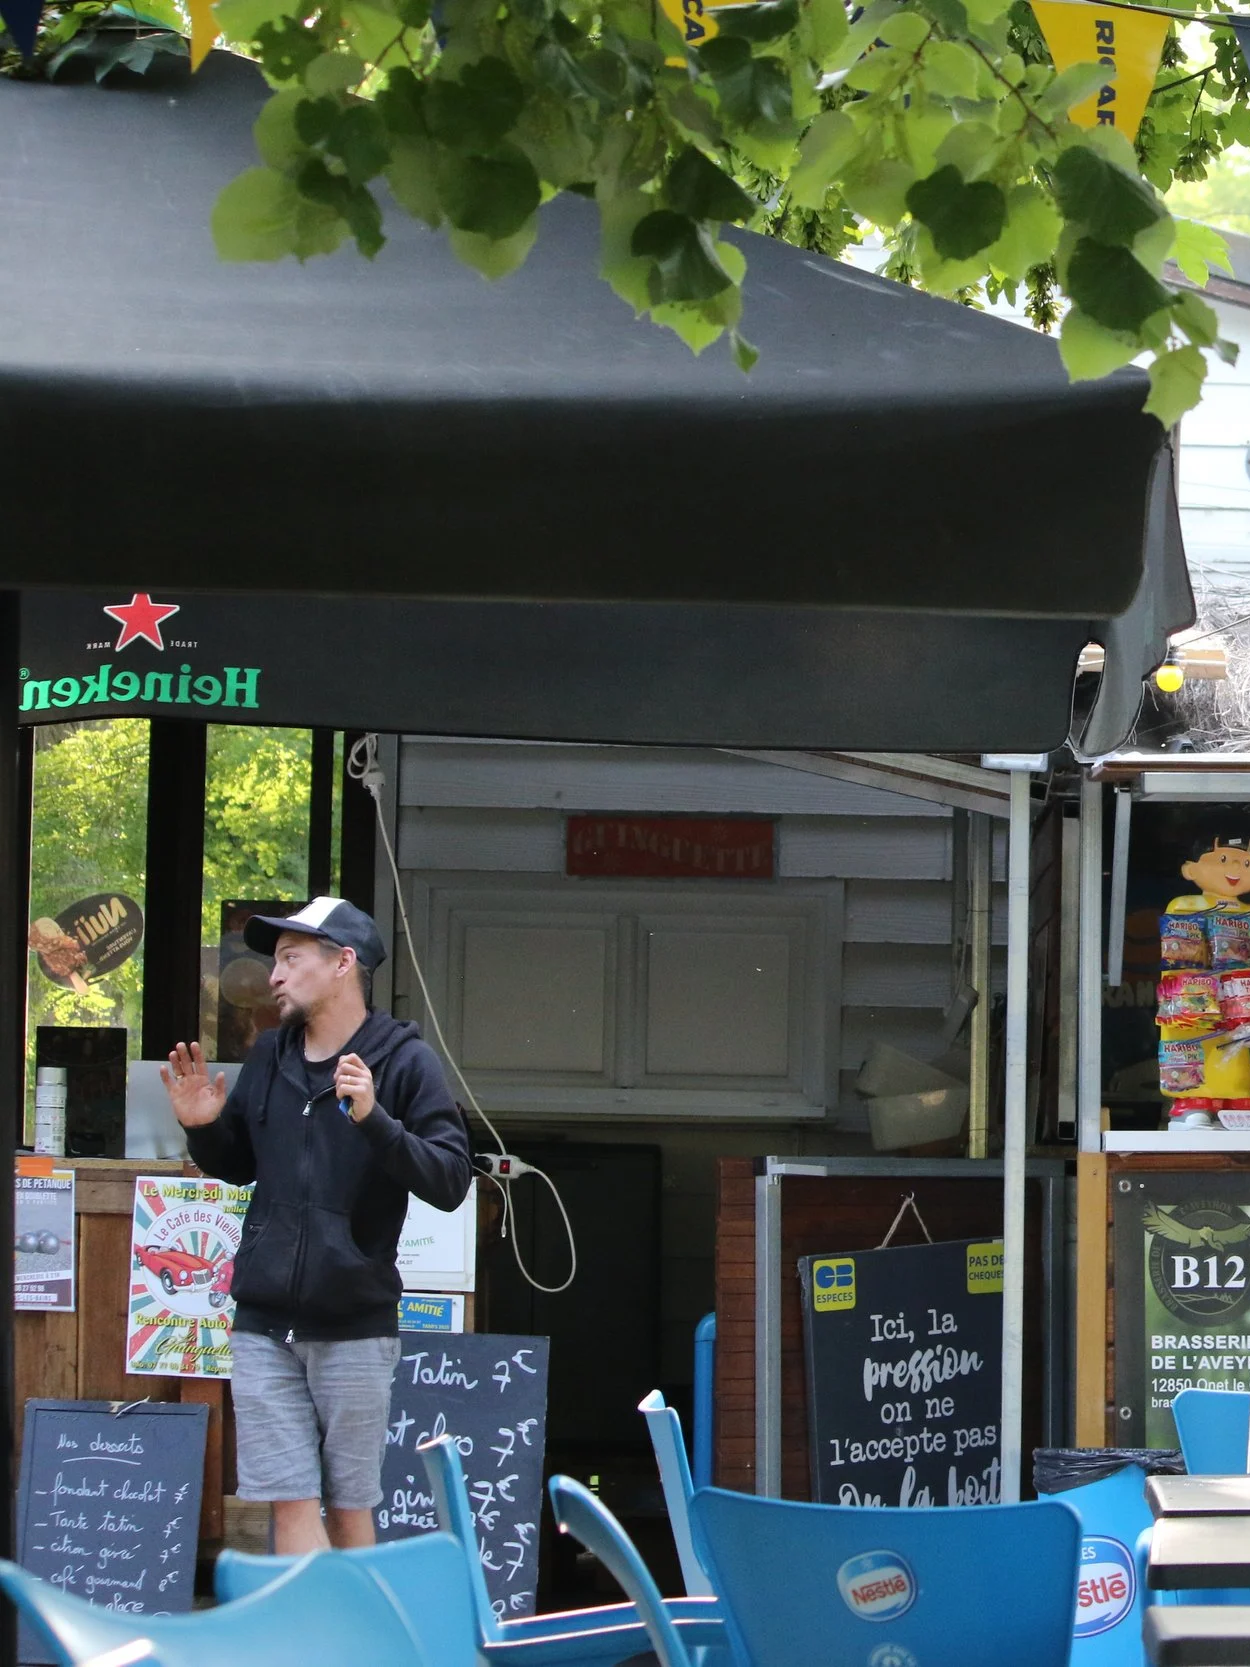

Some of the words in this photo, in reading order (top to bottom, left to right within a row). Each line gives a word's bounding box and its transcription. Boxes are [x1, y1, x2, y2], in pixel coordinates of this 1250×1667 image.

[1168, 922, 1200, 931] HARIBO
[1215, 917, 1250, 930] HARIBO
[1182, 978, 1213, 986] HARIBO
[1164, 1044, 1199, 1053] HARIBO
[34, 1178, 72, 1190] PETANQUE
[143, 1184, 158, 1197] Le
[162, 1185, 223, 1200] Mercredi
[226, 1188, 252, 1201] Mat
[154, 1227, 169, 1241] Le
[166, 1210, 191, 1230] Café
[193, 1209, 213, 1223] des
[215, 1213, 241, 1248] Vieilles
[968, 1255, 989, 1268] PAS
[1171, 1255, 1247, 1289] B12
[816, 1292, 854, 1304] ESPECES
[407, 1302, 445, 1318] AMITIÉ
[135, 1313, 195, 1328] Rencontre
[199, 1318, 228, 1329] Auto
[869, 1312, 915, 1344] Ici,
[927, 1308, 958, 1335] la
[402, 1351, 479, 1390] Tatin
[1151, 1356, 1176, 1370] DE
[863, 1344, 983, 1401] pression
[1151, 1378, 1193, 1393] 12850
[1196, 1377, 1228, 1392] Onet
[1232, 1378, 1245, 1392] le
[880, 1401, 913, 1424] on
[925, 1396, 955, 1418] ne
[57, 1433, 79, 1450] Nos
[90, 1433, 145, 1454] desserts
[829, 1426, 947, 1466] l'accepte
[953, 1425, 997, 1456] pas
[51, 1472, 109, 1507] fondant
[113, 1480, 167, 1504] chocolat
[49, 1510, 90, 1531] Tarte
[86, 1568, 147, 1593] gourmand
